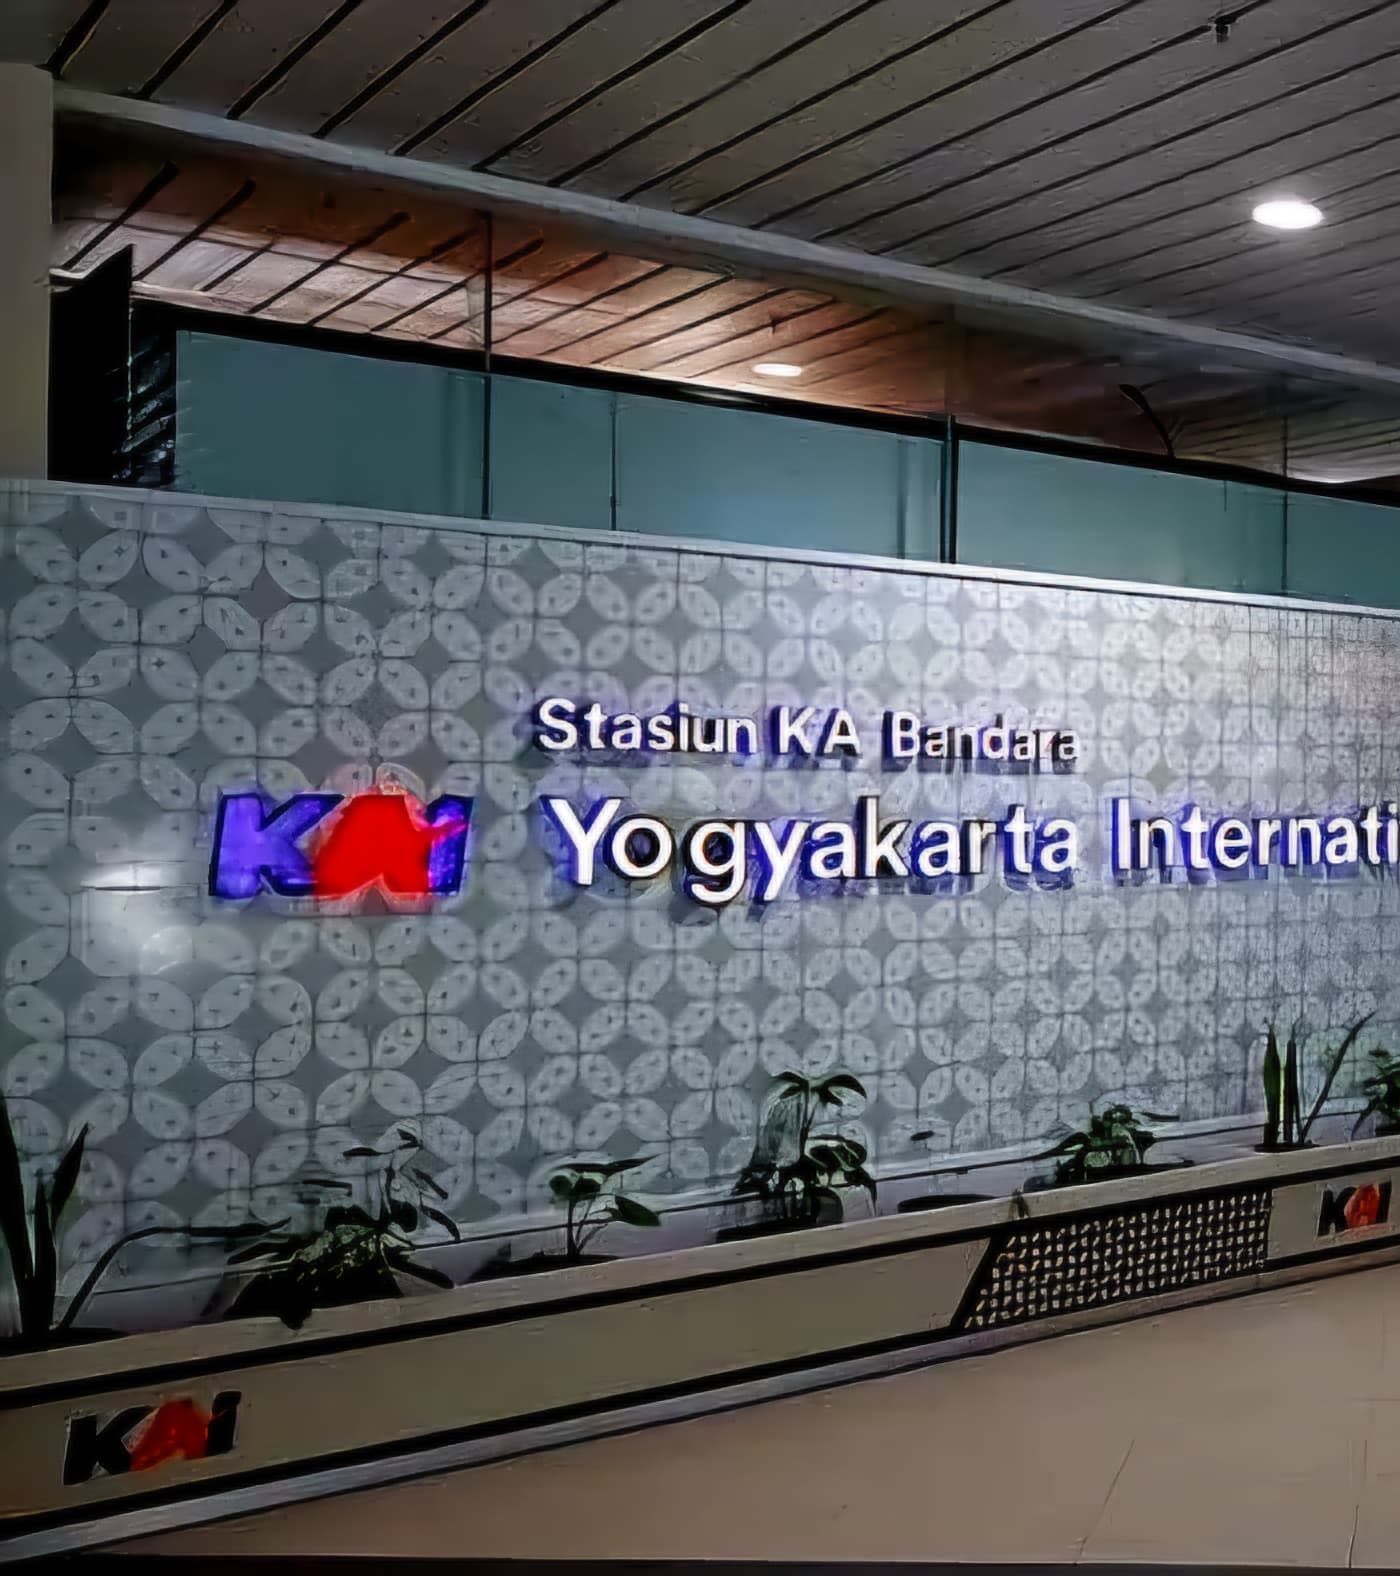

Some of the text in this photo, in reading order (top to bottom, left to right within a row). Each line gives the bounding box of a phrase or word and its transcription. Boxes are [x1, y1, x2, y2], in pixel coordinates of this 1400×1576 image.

[536, 697, 1081, 761] Stasiun KA Bandara
[541, 796, 1079, 904] Yogyakarta
